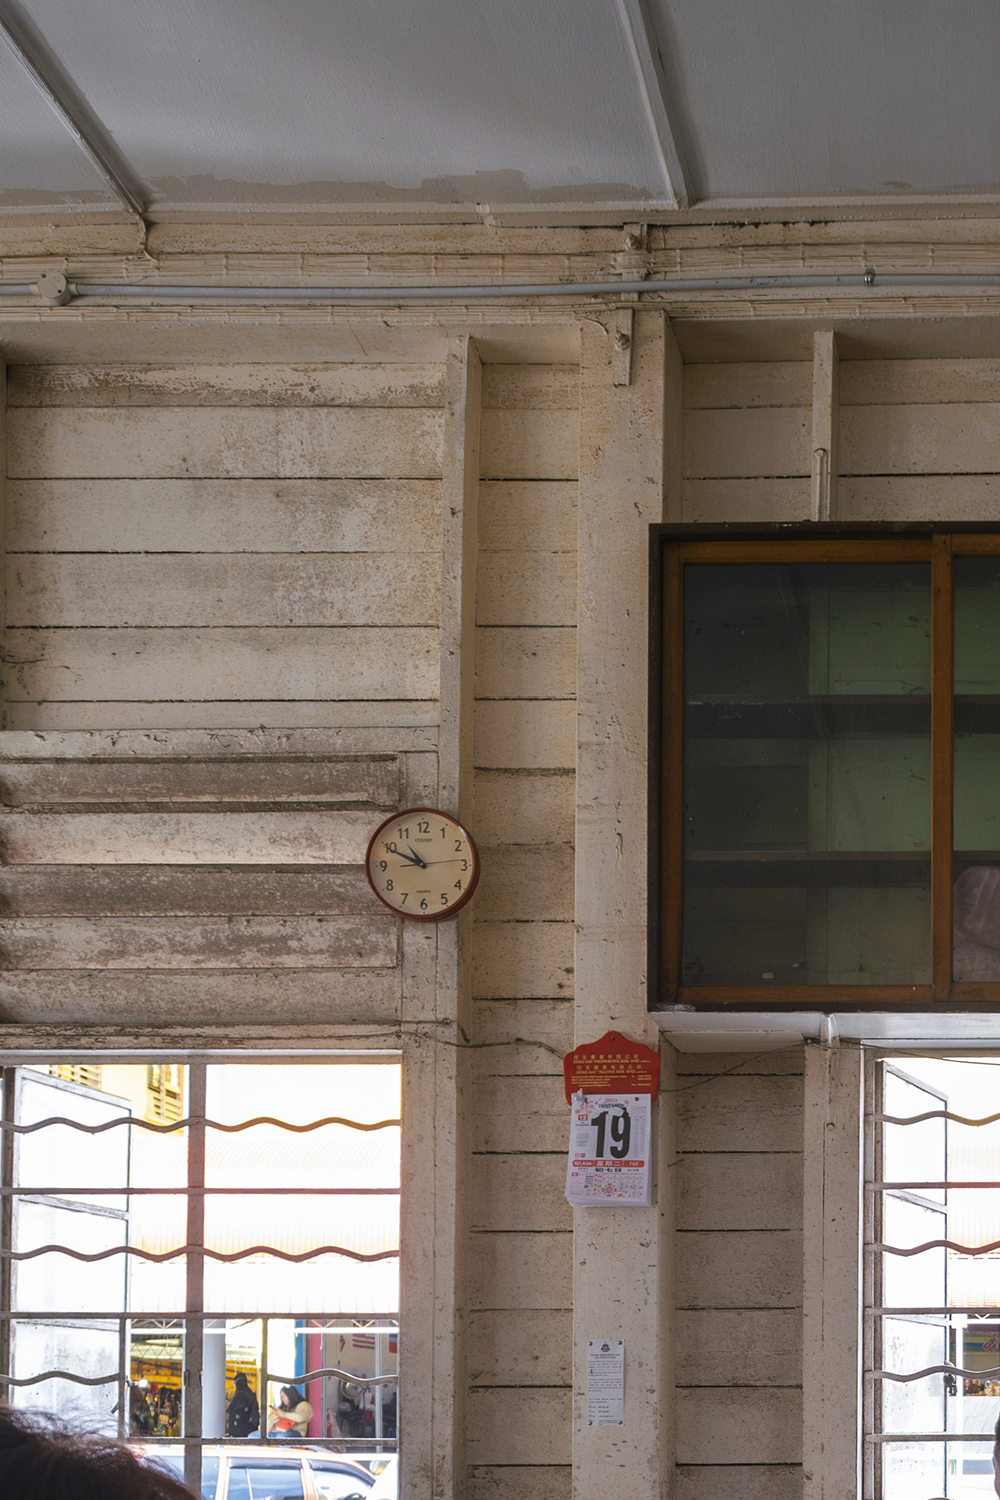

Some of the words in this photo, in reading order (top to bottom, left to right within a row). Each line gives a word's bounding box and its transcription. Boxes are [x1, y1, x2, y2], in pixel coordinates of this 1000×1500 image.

[397, 827, 409, 839] 11
[417, 821, 430, 834] 12
[440, 827, 446, 839] 1
[384, 842, 397, 854] 10
[454, 840, 462, 852] 2
[379, 860, 387, 872] 9
[460, 859, 468, 871] 3
[386, 879, 394, 891] 8
[453, 879, 462, 890] 4
[400, 893, 409, 905] 7
[420, 898, 428, 910] 6
[440, 893, 448, 905] 5
[591, 1108, 631, 1158] 19
